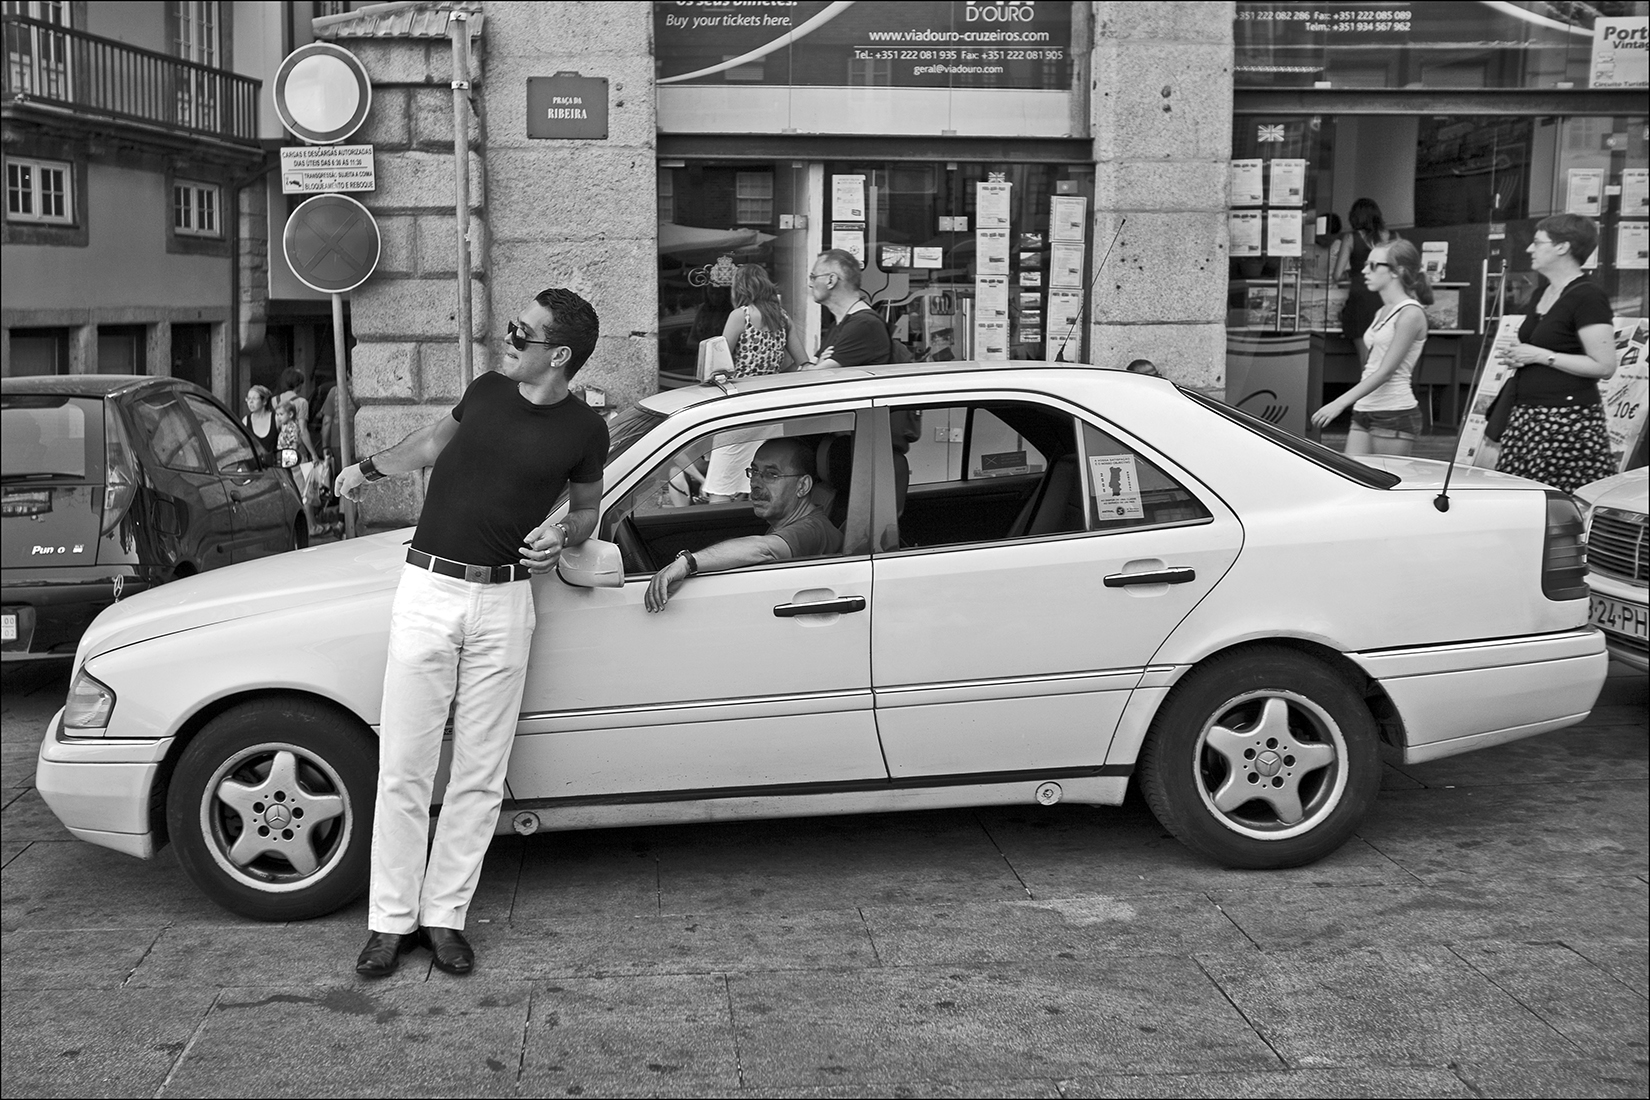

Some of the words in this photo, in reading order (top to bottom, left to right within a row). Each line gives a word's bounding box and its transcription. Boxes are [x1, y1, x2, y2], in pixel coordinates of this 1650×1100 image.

[966, 6, 1035, 22] D'OURO
[1257, 11, 1274, 20] 222
[1275, 11, 1292, 20] 082
[1333, 11, 1355, 20] +351
[1357, 11, 1374, 20] 222
[666, 14, 689, 29] Buy
[692, 16, 721, 29] your
[722, 14, 761, 26] tickets
[762, 14, 792, 26] here.
[1333, 22, 1355, 31] +351
[1357, 22, 1374, 31] 934
[1375, 22, 1392, 31] 567
[1394, 22, 1411, 31] 962
[869, 29, 1049, 42] www.viadouro-cruzeiros.com
[1604, 26, 1648, 40] Port
[875, 50, 898, 60] +351
[900, 50, 918, 60] 222
[920, 50, 937, 60] 081
[939, 50, 957, 60] 935
[961, 50, 979, 60] Fax:
[981, 50, 1004, 60] +351
[1007, 50, 1024, 60] 222
[1026, 50, 1043, 60] 081
[1046, 50, 1063, 60] 905
[913, 64, 1003, 75] geral@viadouro.com
[553, 96, 573, 106] PRAÇA
[548, 108, 588, 119] RIBEIRA
[1613, 400, 1640, 419] 10€
